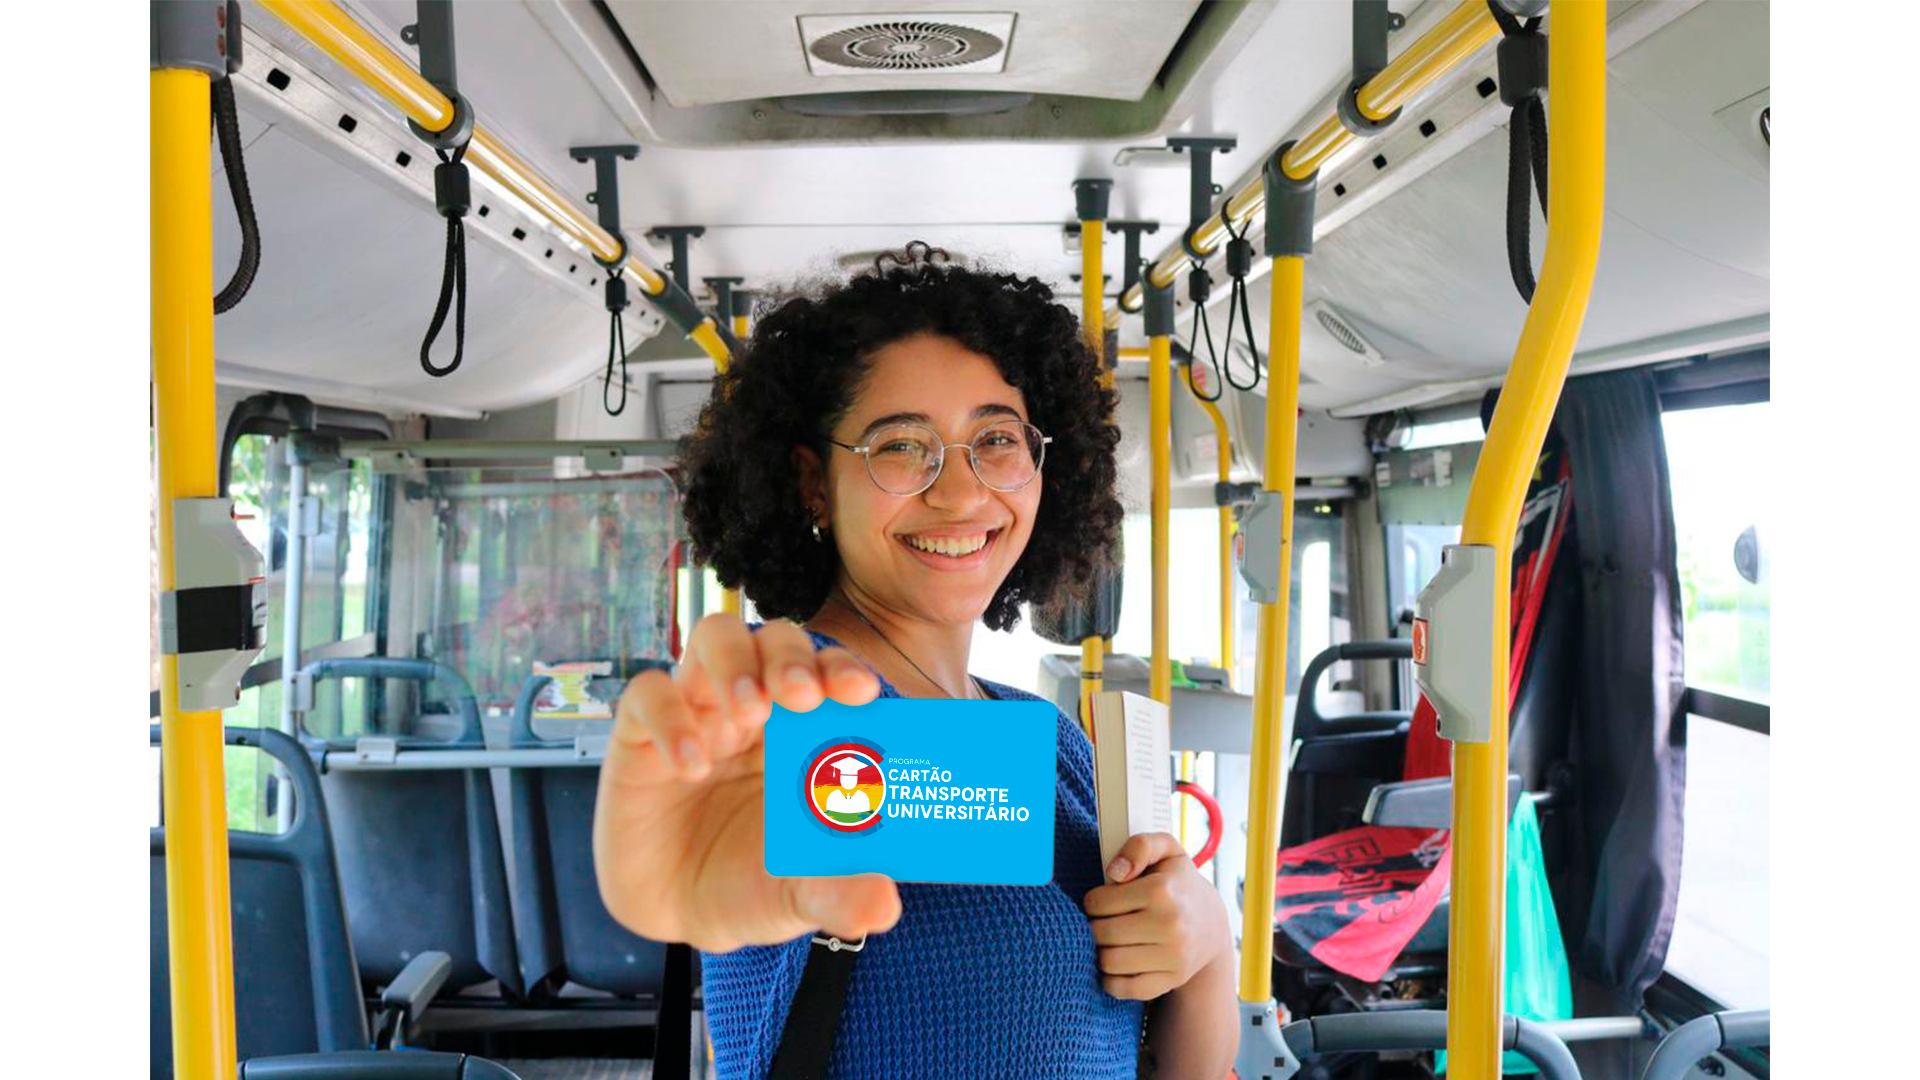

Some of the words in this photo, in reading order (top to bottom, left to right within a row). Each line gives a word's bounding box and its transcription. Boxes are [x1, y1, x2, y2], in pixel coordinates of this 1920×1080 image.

[888, 758, 931, 766] PROGRAMA
[888, 767, 952, 783] CARTÃO
[888, 785, 1009, 803] TRANSPORTE
[887, 802, 1030, 822] UNIVERSITÁRIO
